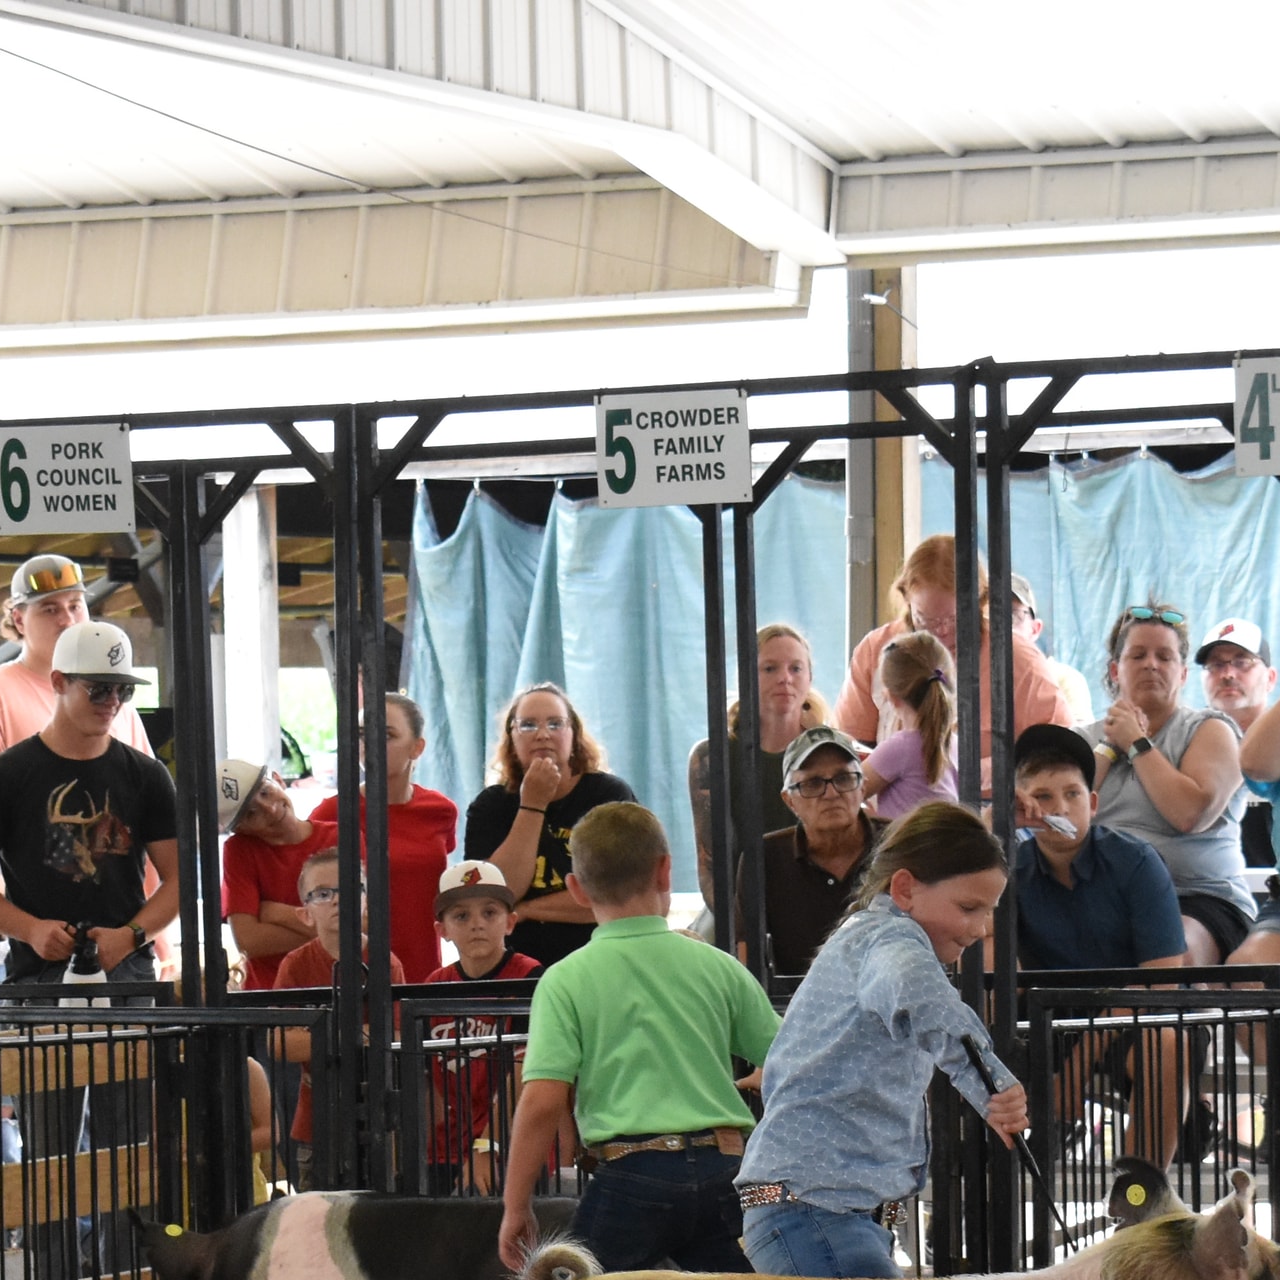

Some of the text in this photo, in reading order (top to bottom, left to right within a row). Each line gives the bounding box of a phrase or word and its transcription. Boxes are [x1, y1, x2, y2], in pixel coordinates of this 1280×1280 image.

[635, 406, 740, 430] CROWDER
[1239, 372, 1275, 460] 4
[50, 441, 104, 460] PORK
[604, 408, 637, 495] 5
[653, 434, 726, 457] FAMILY
[0, 437, 31, 523] 6
[36, 467, 123, 487] COUNCIL
[655, 462, 726, 484] FARMS
[42, 493, 117, 513] WOMEN
